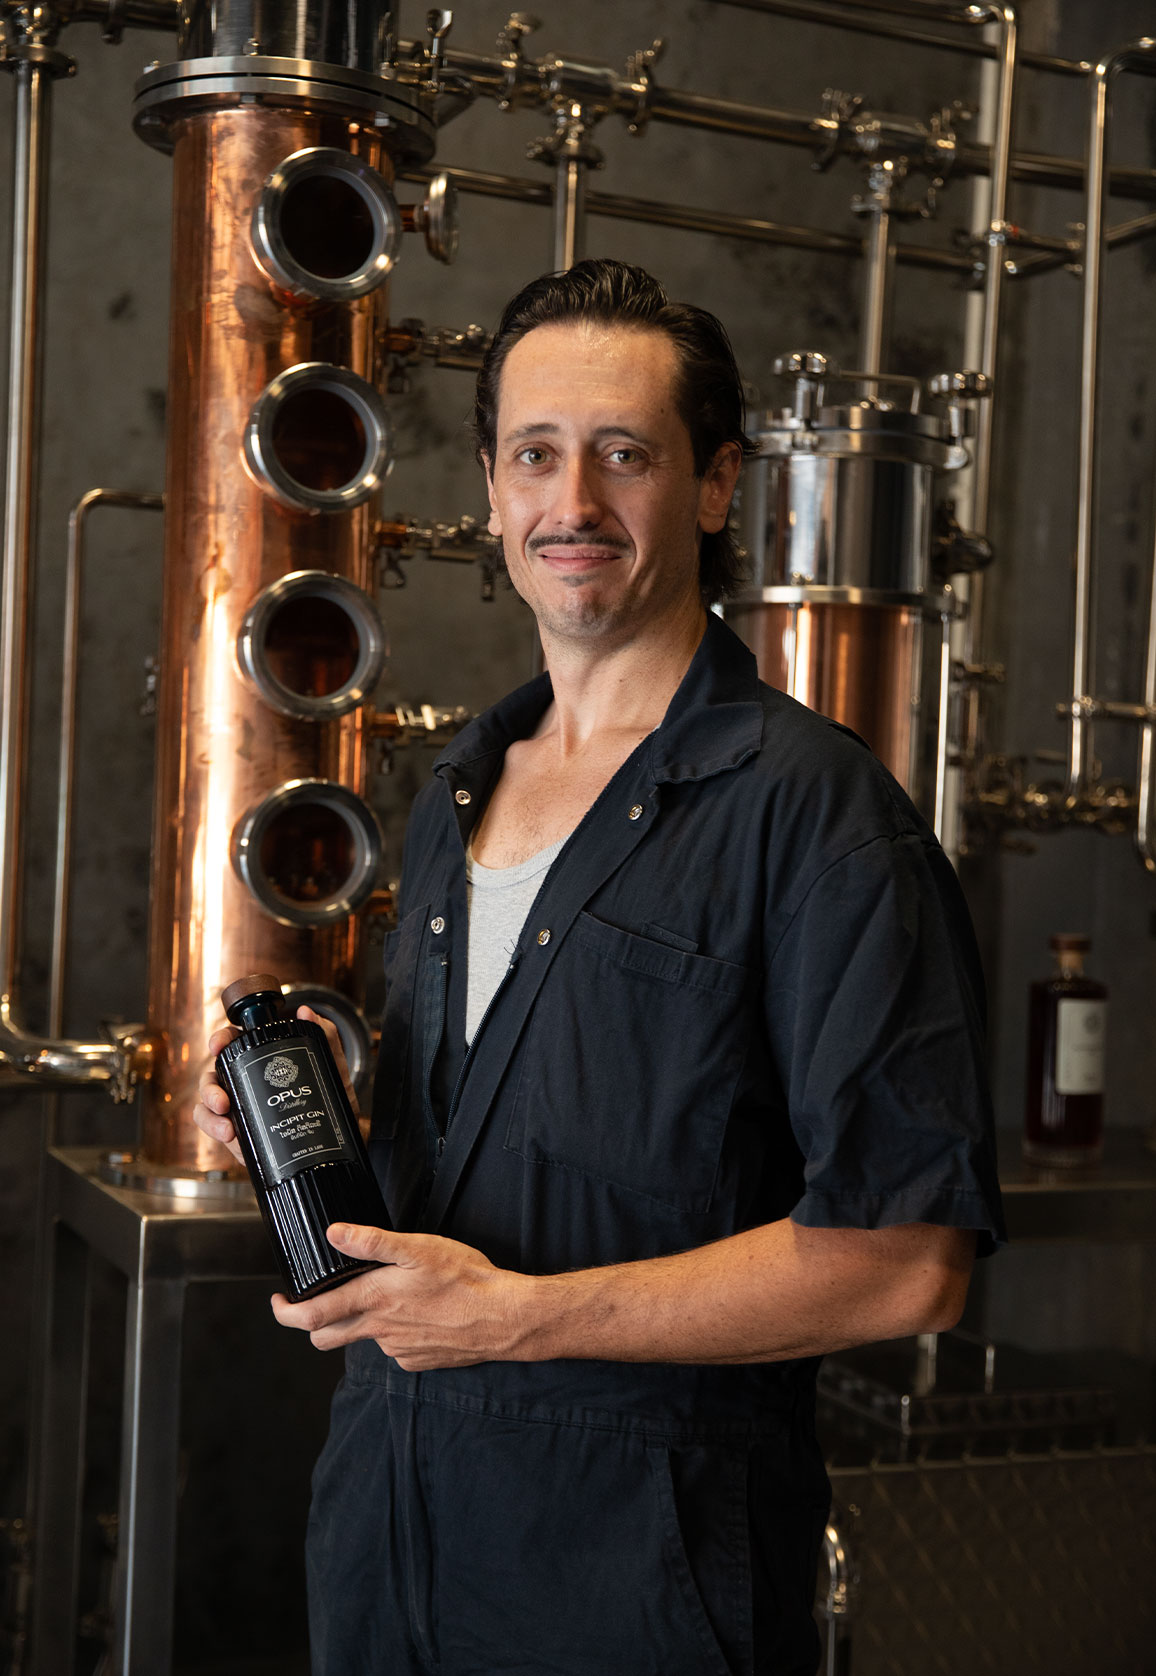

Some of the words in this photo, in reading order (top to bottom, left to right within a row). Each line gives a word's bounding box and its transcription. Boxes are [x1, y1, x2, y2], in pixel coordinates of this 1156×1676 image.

[267, 1085, 312, 1107] OPUS
[270, 1113, 305, 1133] INCIPIT
[306, 1110, 325, 1119] GIN
